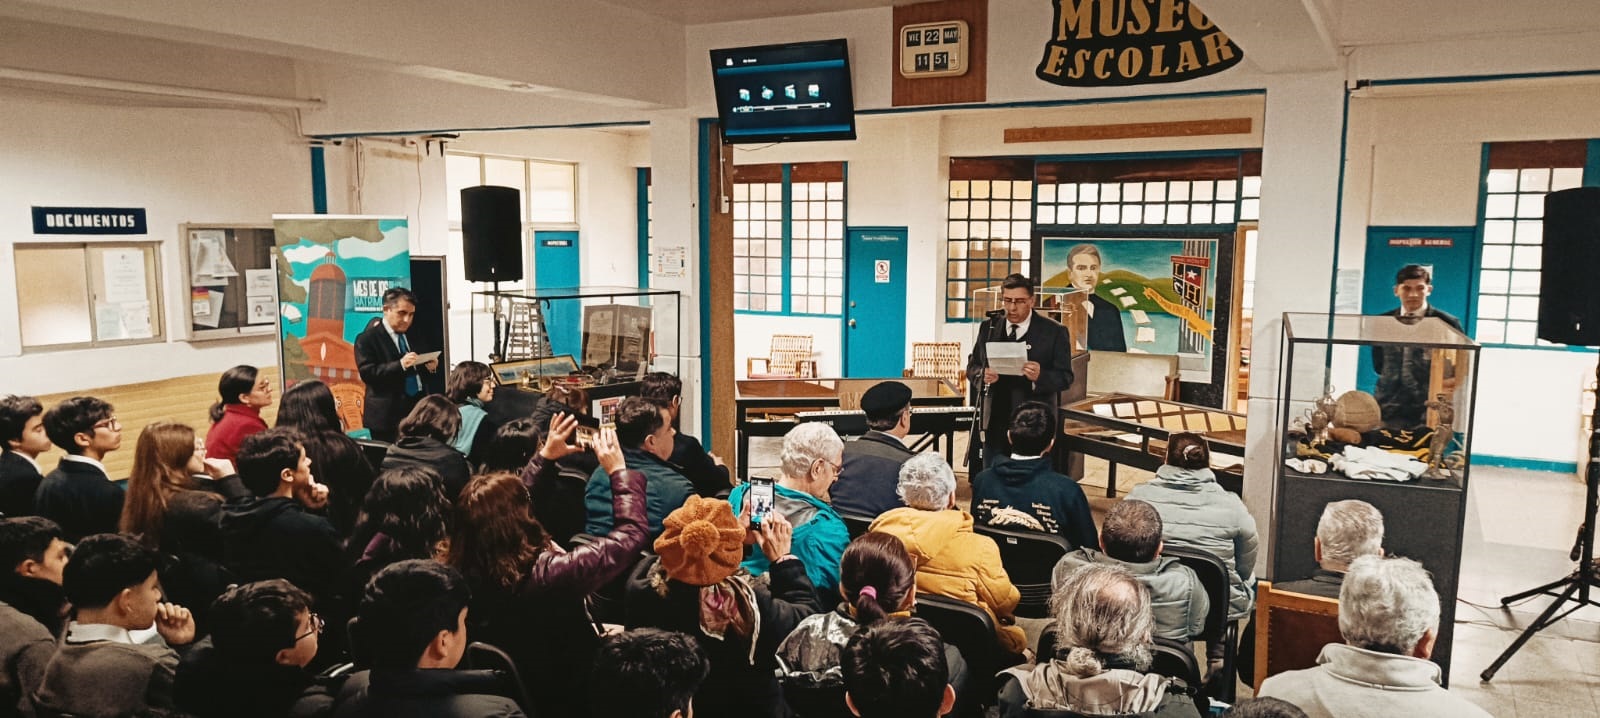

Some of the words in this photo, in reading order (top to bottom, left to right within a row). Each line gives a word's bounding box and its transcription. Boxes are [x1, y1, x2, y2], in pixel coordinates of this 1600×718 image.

[908, 33, 920, 42] VIE
[925, 31, 939, 42] 22
[944, 29, 957, 40] MAY
[917, 55, 928, 66] 11
[935, 53, 947, 65] 51
[1043, 31, 1234, 79] ESCOLAR
[46, 213, 136, 228] DOCUMENTOS
[369, 280, 378, 297] DE
